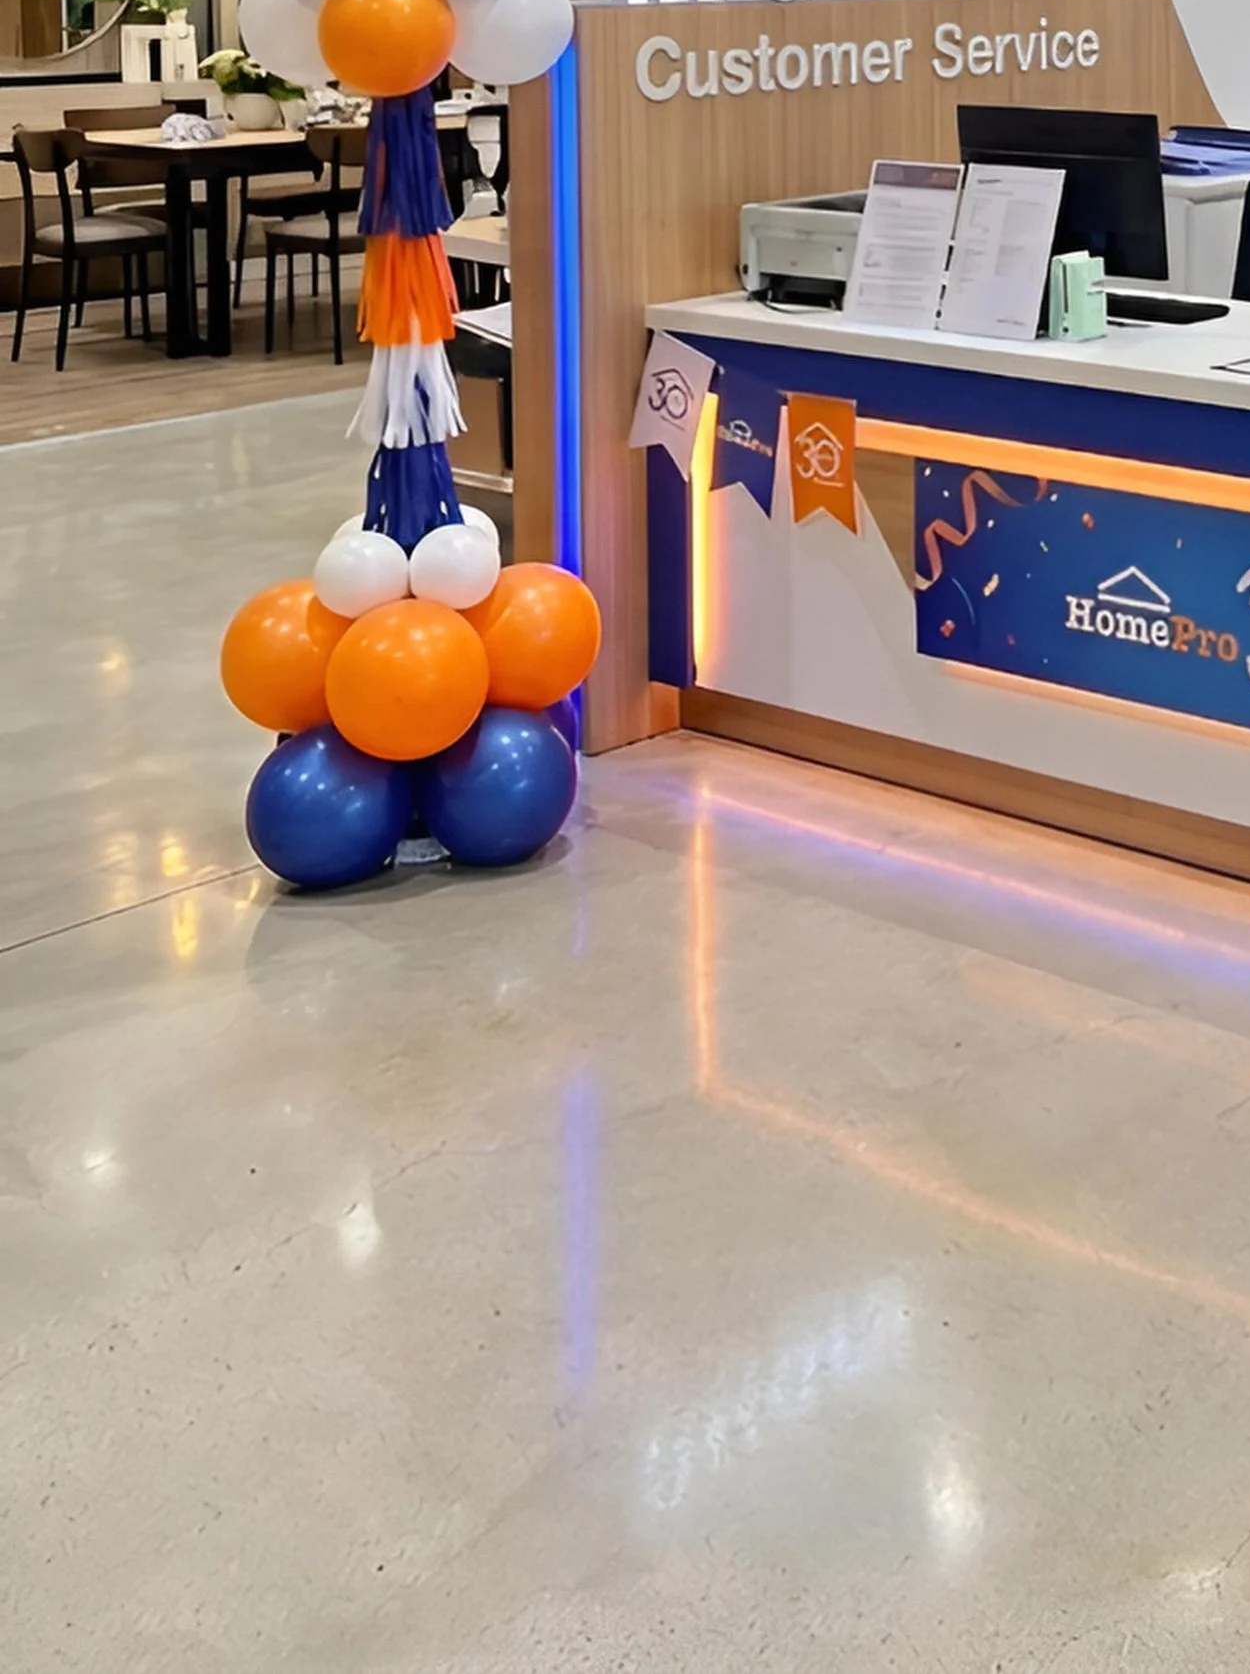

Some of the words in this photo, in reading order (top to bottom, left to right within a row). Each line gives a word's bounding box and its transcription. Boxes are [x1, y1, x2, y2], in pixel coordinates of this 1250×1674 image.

[635, 33, 912, 103] Customer
[931, 17, 1101, 79] Service
[1065, 594, 1239, 663] HomePro
